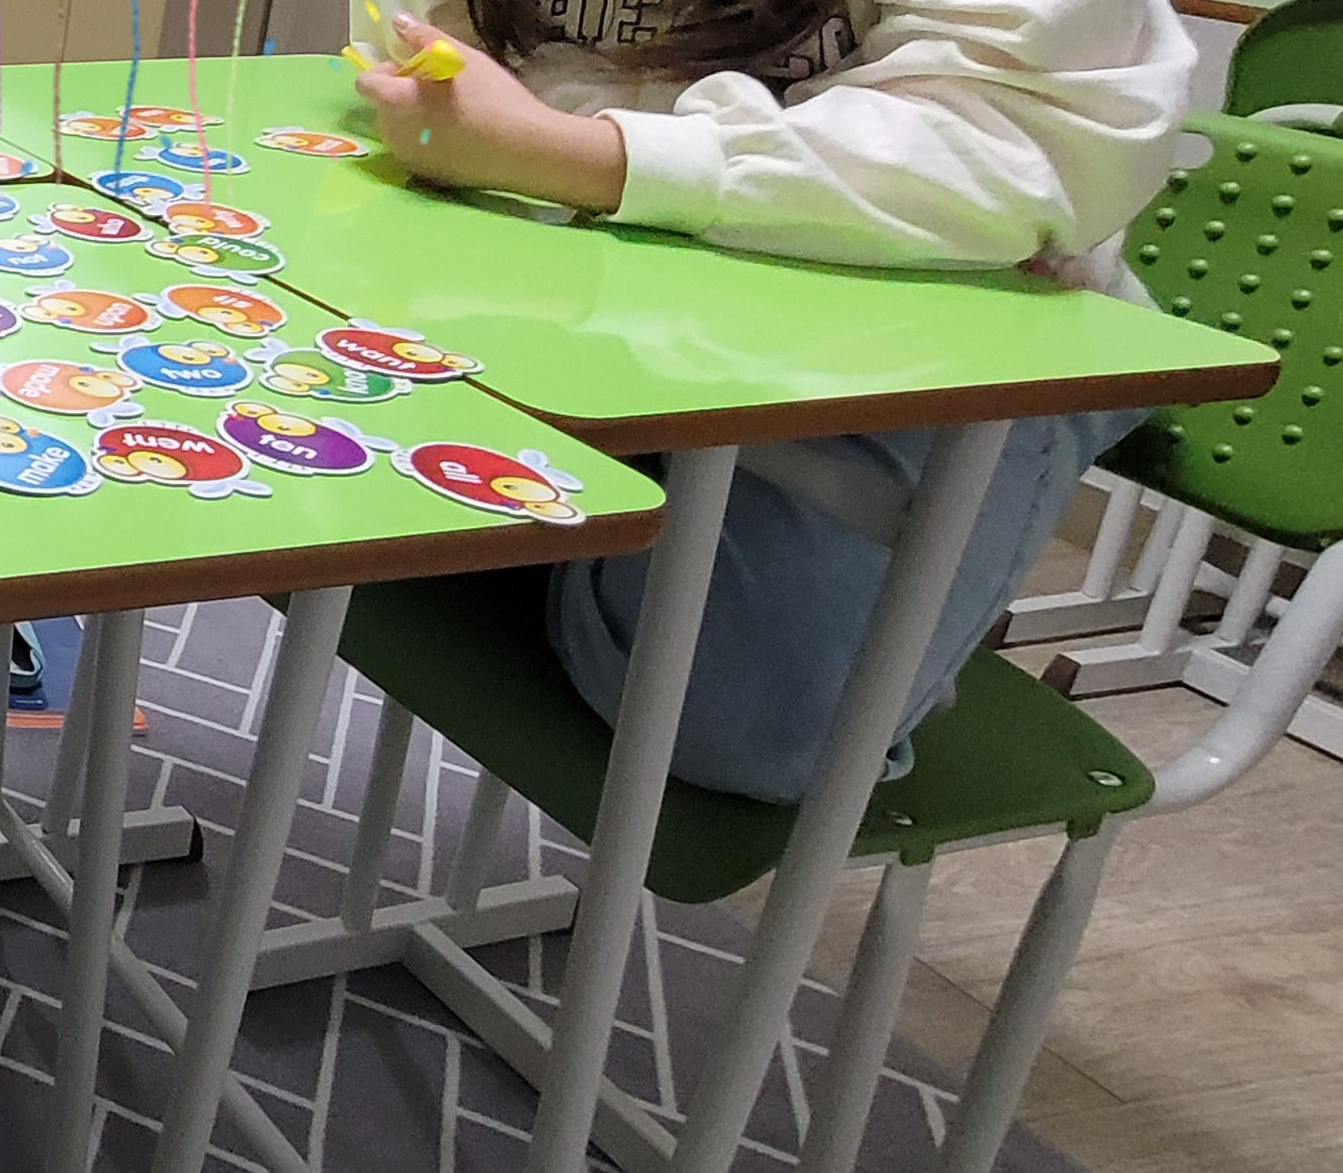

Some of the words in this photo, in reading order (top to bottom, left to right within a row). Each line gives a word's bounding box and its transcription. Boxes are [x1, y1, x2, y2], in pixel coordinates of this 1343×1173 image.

[198, 237, 272, 262] could
[336, 336, 417, 372] want
[22, 365, 61, 400] made
[160, 362, 224, 383] two
[122, 432, 216, 456] went
[259, 433, 320, 461] ten
[15, 444, 71, 487] make
[438, 459, 482, 486] all
